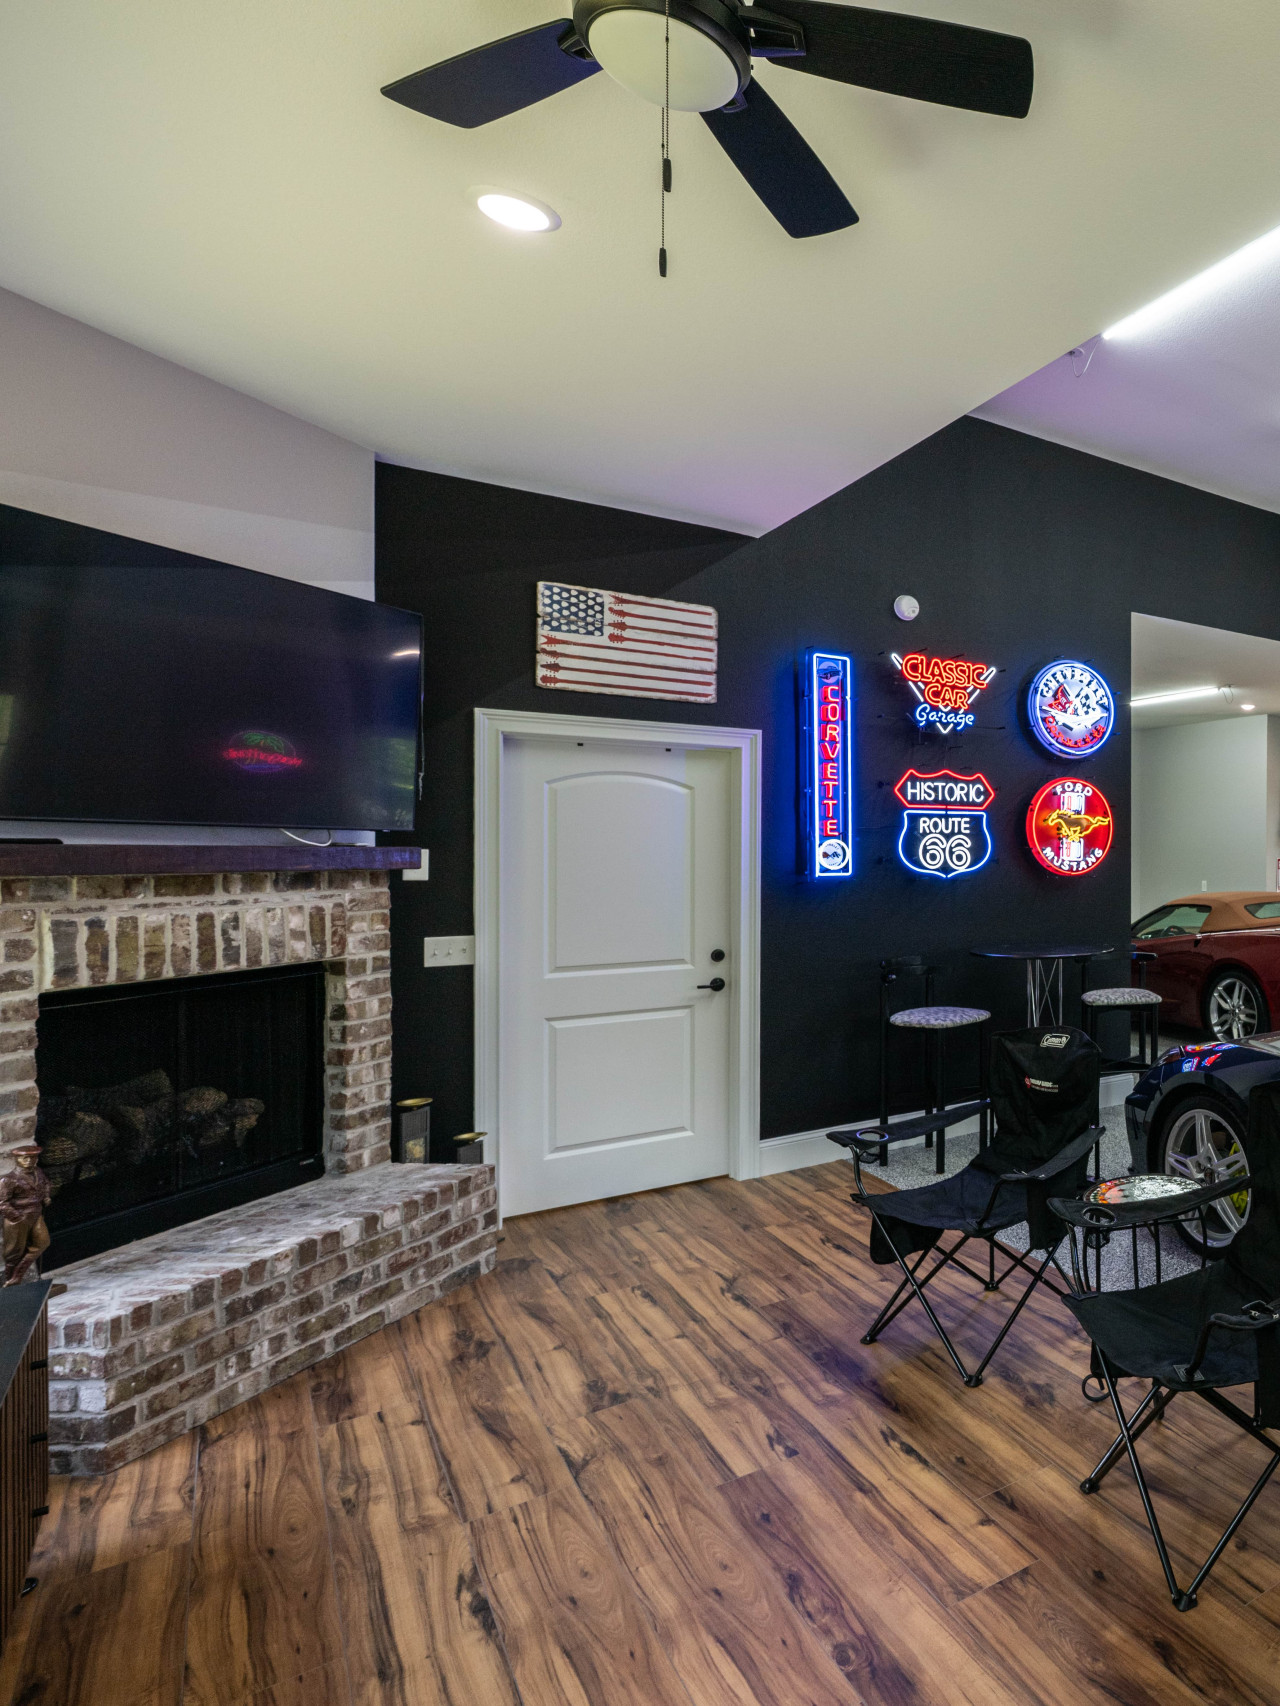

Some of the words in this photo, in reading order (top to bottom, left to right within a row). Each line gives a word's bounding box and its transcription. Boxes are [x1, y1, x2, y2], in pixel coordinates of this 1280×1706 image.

[902, 653, 989, 689] CLASSIC
[923, 683, 969, 710] CAR
[1039, 666, 1109, 708] CHEVROLET
[915, 703, 976, 731] Garage
[822, 685, 842, 837] CORVETTE
[906, 780, 985, 804] HISTORIC
[1055, 781, 1094, 798] FORD
[919, 816, 971, 834] ROUTE
[918, 834, 972, 871] 66
[1042, 845, 1104, 873] MUSTANG
